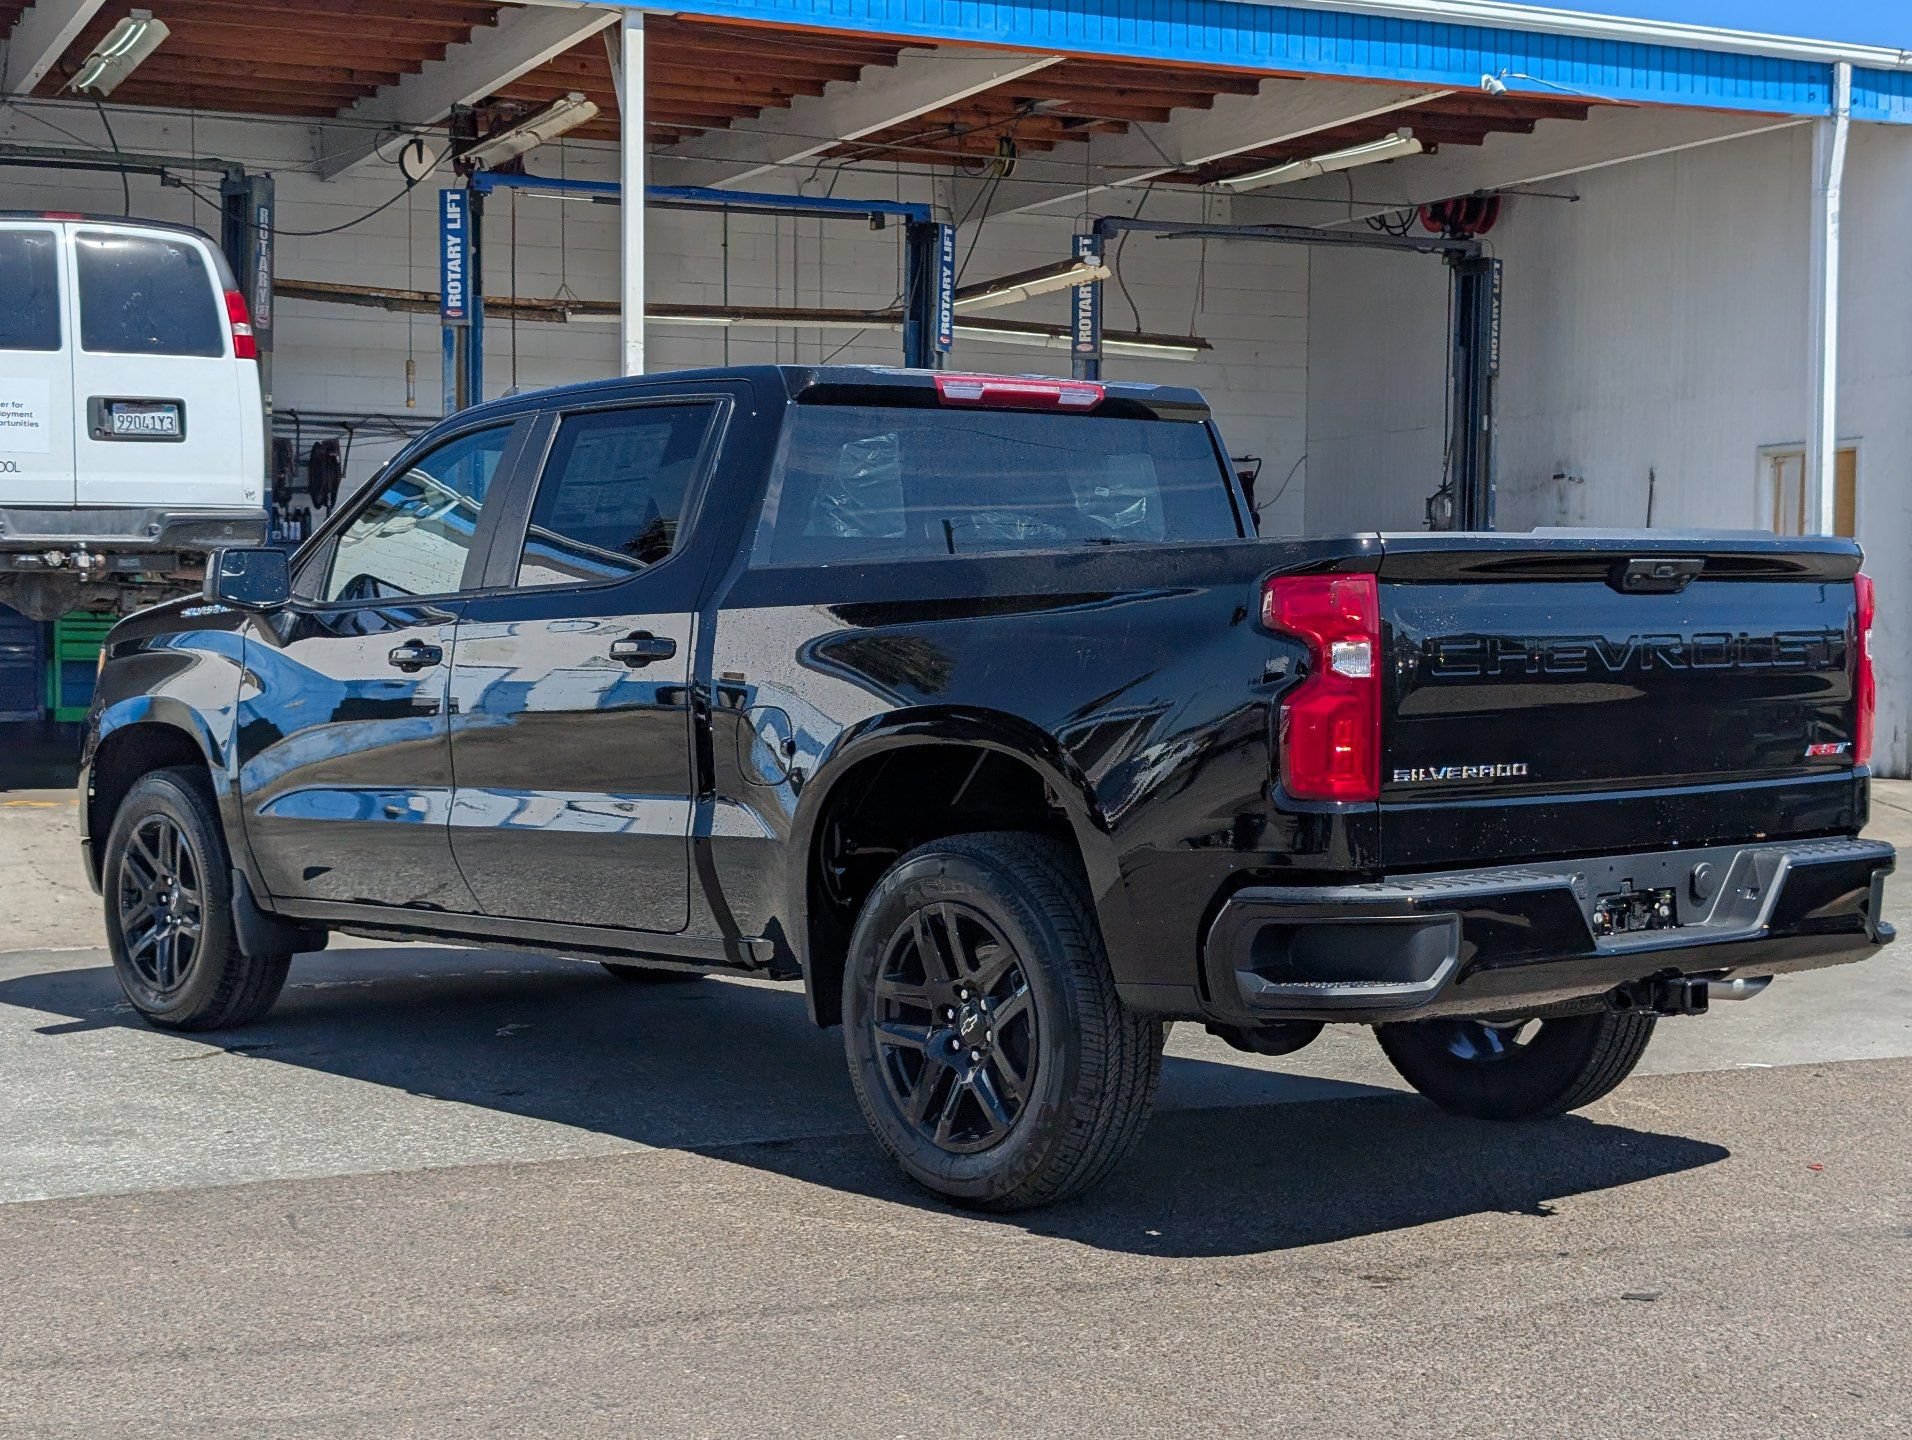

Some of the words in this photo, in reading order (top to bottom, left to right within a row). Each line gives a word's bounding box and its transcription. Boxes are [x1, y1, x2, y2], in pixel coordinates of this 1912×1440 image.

[446, 191, 461, 229] LIFT
[259, 207, 269, 303] ROTARY
[943, 226, 953, 262] LIFT
[1079, 236, 1092, 257] FT
[447, 234, 462, 307] ROTARY
[1493, 261, 1501, 294] LIFT
[941, 266, 952, 335] ROTARY
[1079, 281, 1092, 342] ROTAR
[1491, 298, 1499, 361] ROTARY
[12, 401, 24, 409] for
[117, 414, 174, 431] 99041Y3
[1430, 630, 1845, 677] CHEVROLET
[1804, 742, 1852, 757] RST
[1393, 763, 1528, 782] SILVERADO
